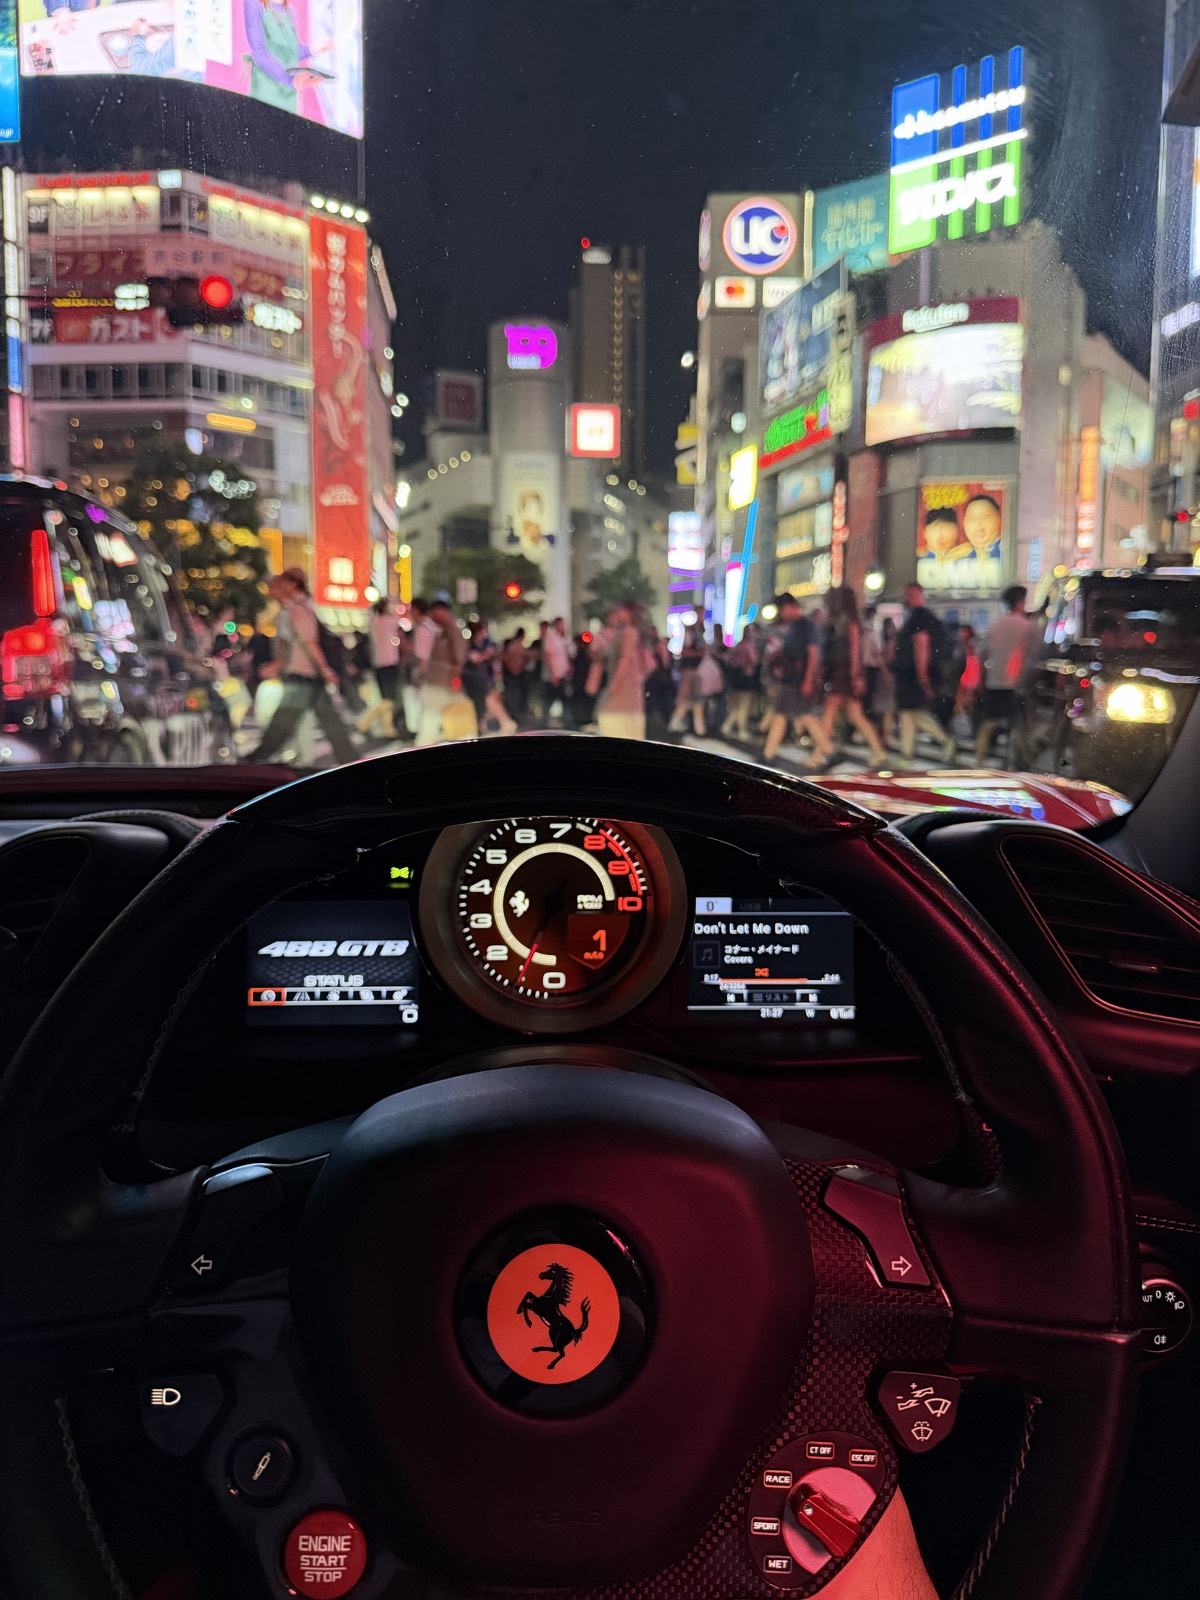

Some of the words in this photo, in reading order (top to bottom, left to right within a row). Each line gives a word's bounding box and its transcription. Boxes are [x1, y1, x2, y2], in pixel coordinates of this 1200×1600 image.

[515, 828, 537, 844] 6
[549, 823, 572, 838] 7
[584, 835, 607, 850] 8
[486, 849, 508, 864] 5
[608, 860, 630, 876] 9
[469, 879, 492, 895] 4
[617, 896, 642, 912] 10
[470, 913, 492, 929] 3
[694, 922, 726, 935] Don't
[729, 922, 750, 935] Let
[752, 923, 771, 935] Me
[774, 923, 809, 935] Down
[592, 929, 607, 952] 1
[257, 940, 337, 957] 488
[337, 940, 410, 957] GTB
[486, 945, 508, 961] 2
[303, 974, 364, 987] STATUS
[543, 972, 566, 989] 0
[402, 1009, 419, 1024] 0
[851, 1454, 863, 1462] ESC
[863, 1454, 876, 1462] OFF
[765, 1475, 791, 1483] RACE
[753, 1522, 779, 1530] SPORT
[298, 1535, 351, 1552] ENGINE
[300, 1555, 348, 1566] START
[768, 1560, 789, 1568] WET
[304, 1571, 342, 1582] STOP
